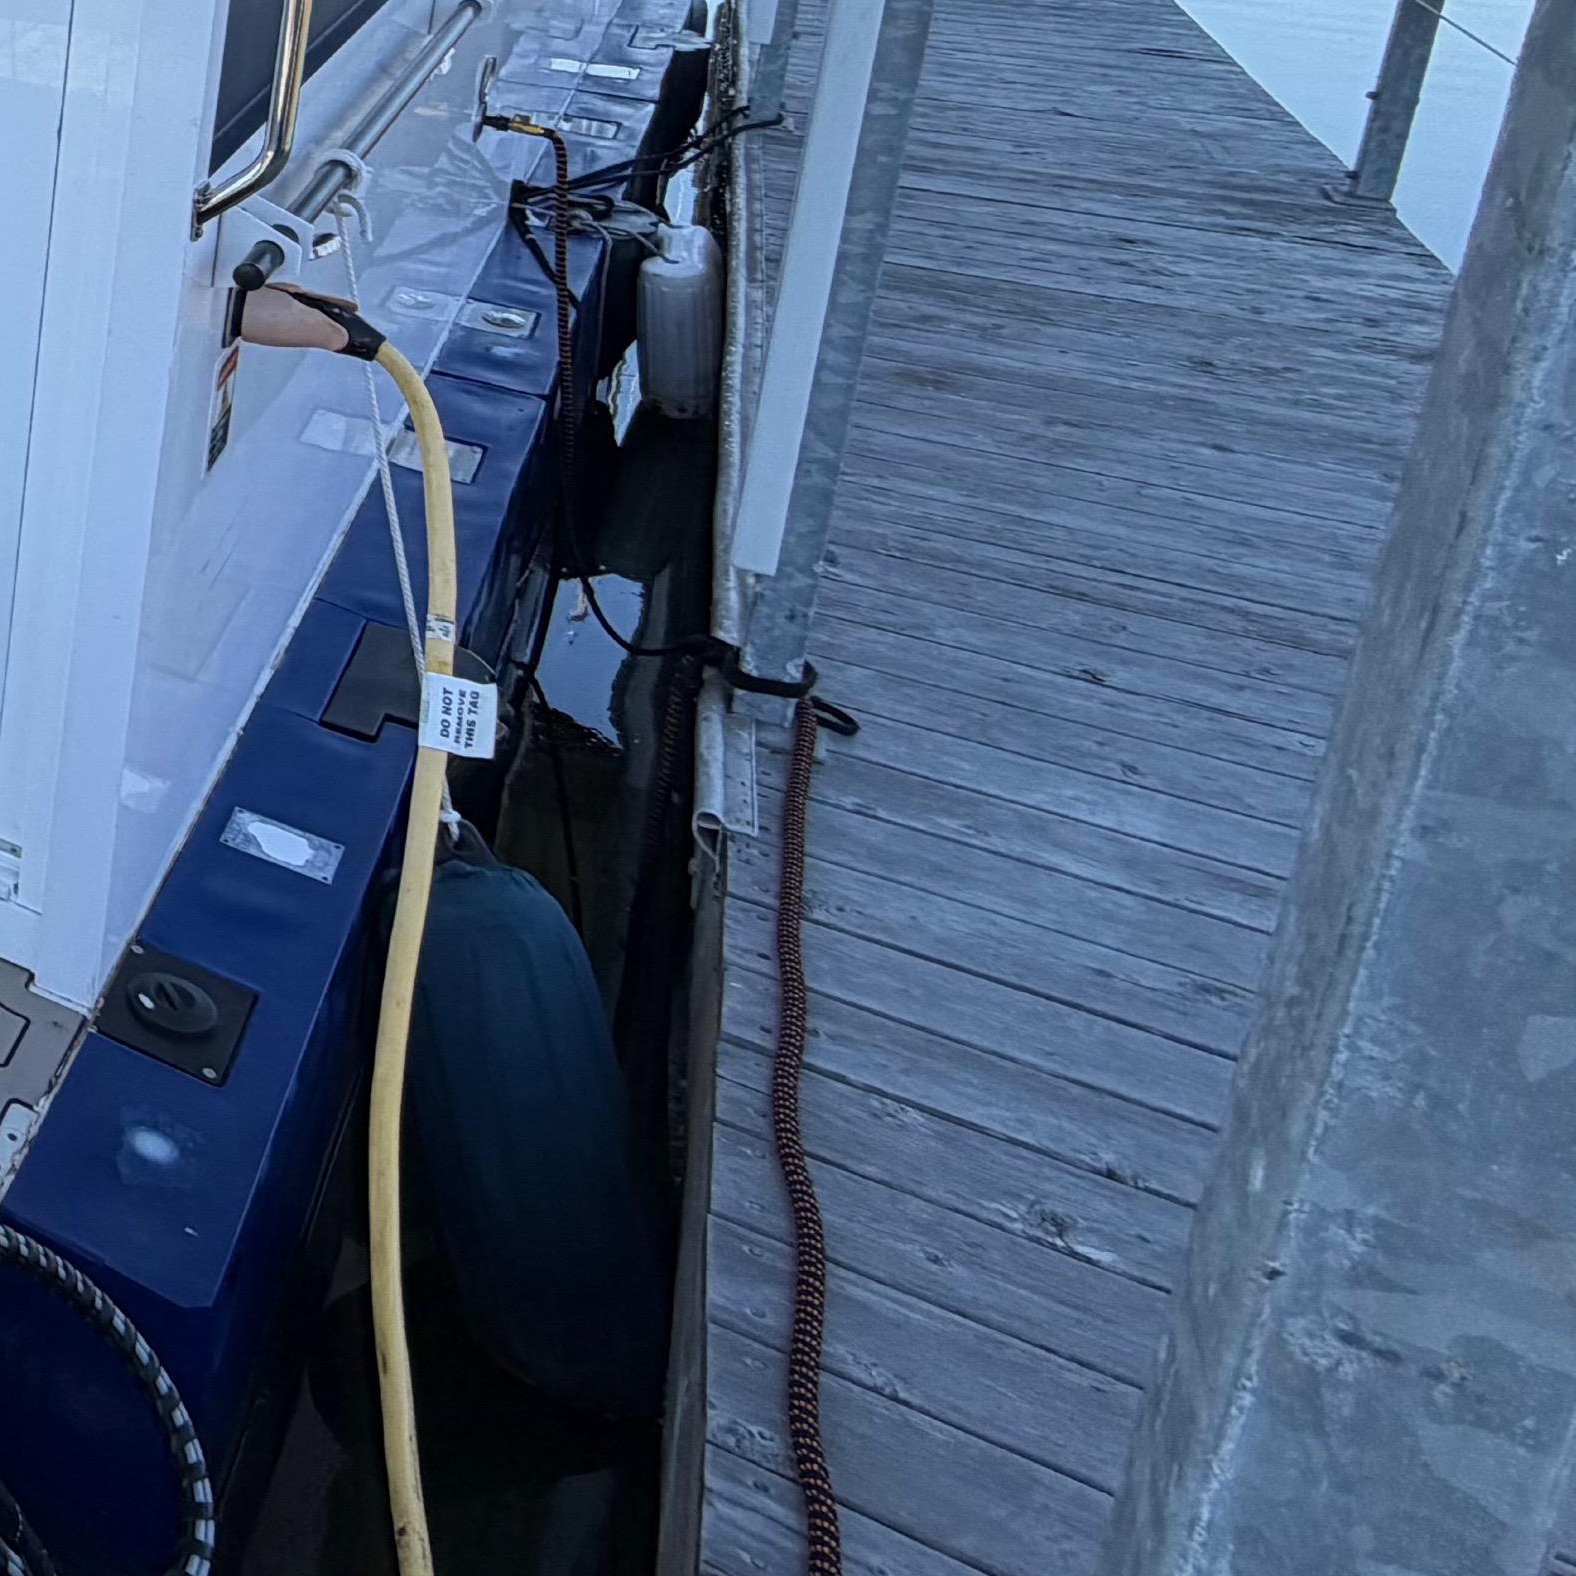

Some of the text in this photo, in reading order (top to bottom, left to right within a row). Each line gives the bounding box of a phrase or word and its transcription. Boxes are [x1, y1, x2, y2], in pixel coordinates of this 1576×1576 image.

[440, 687, 454, 739] DO NOT
[454, 689, 468, 744] REMOVE
[464, 691, 480, 749] THIS TAG
